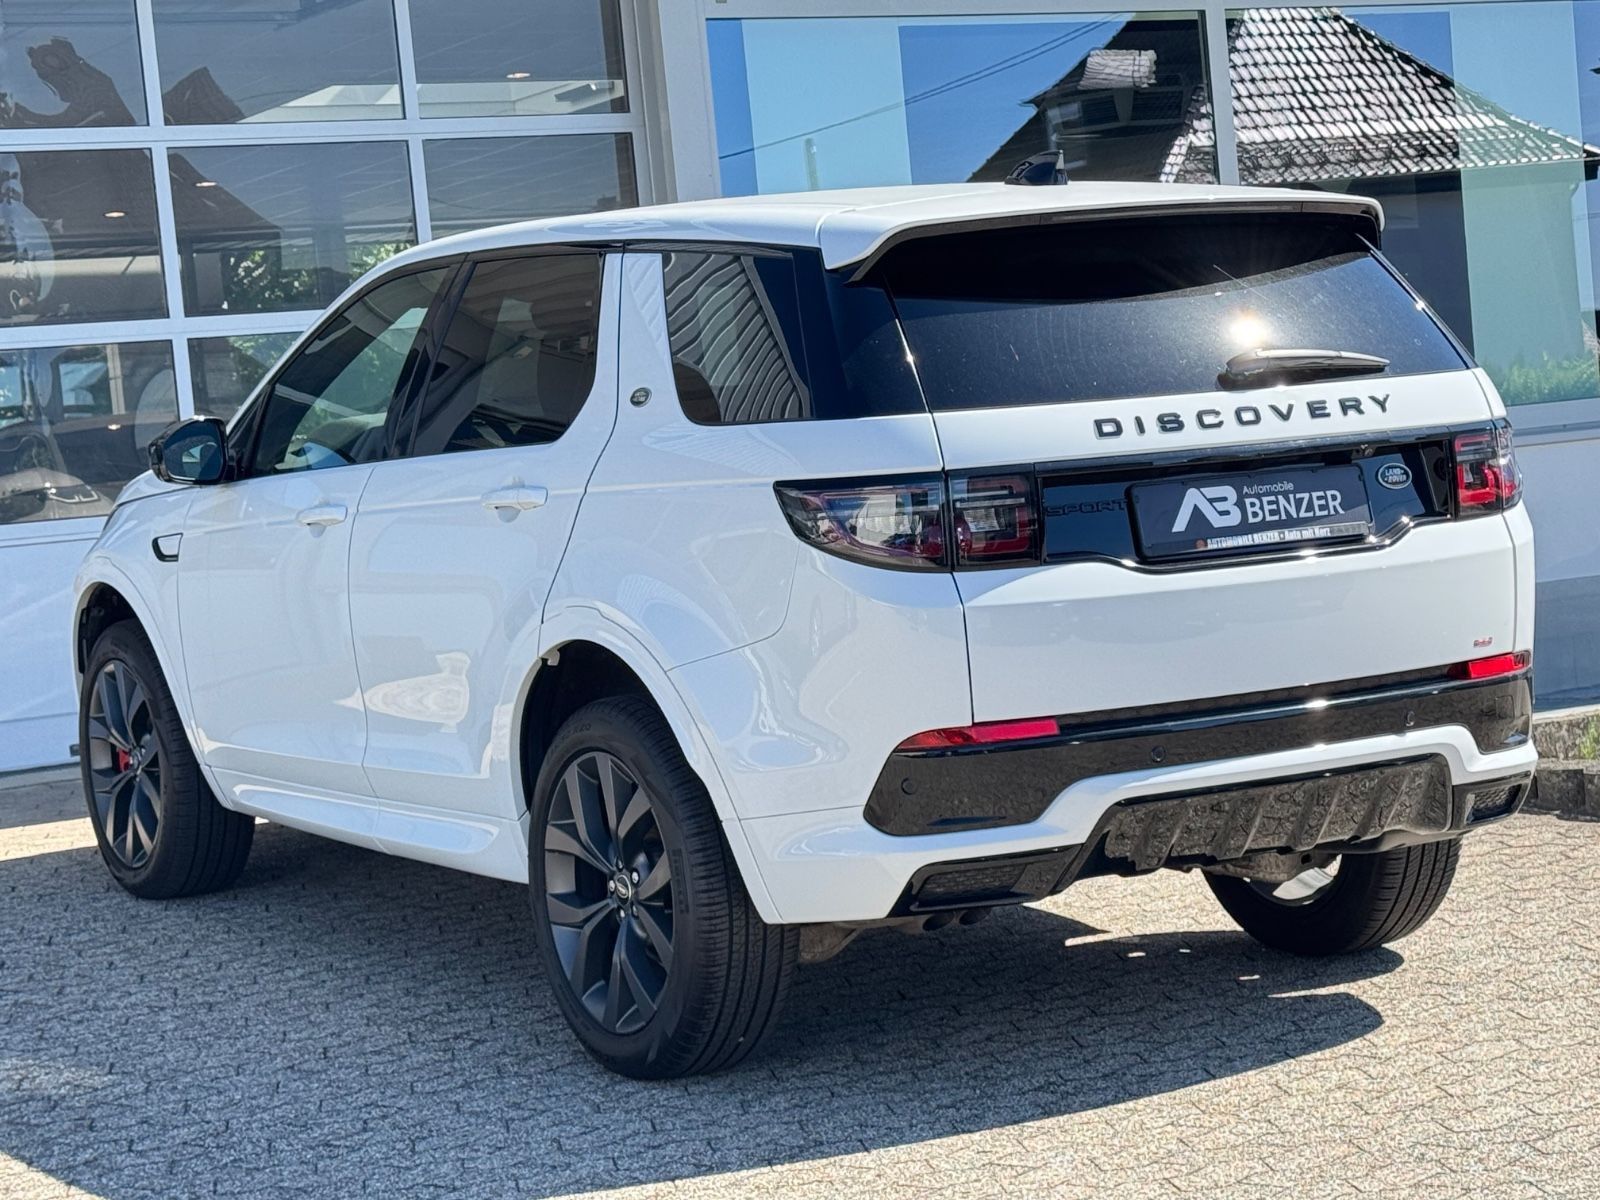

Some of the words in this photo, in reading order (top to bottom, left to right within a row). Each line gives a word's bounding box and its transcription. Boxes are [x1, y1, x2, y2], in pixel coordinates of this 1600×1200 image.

[1093, 394, 1391, 440] DISCOVERY
[1242, 481, 1294, 496] Automobile
[1046, 498, 1127, 516] SPORT
[1247, 489, 1345, 524] BENZER
[1207, 535, 1254, 549] AUTOMOBILE
[1255, 531, 1280, 544] BENZER
